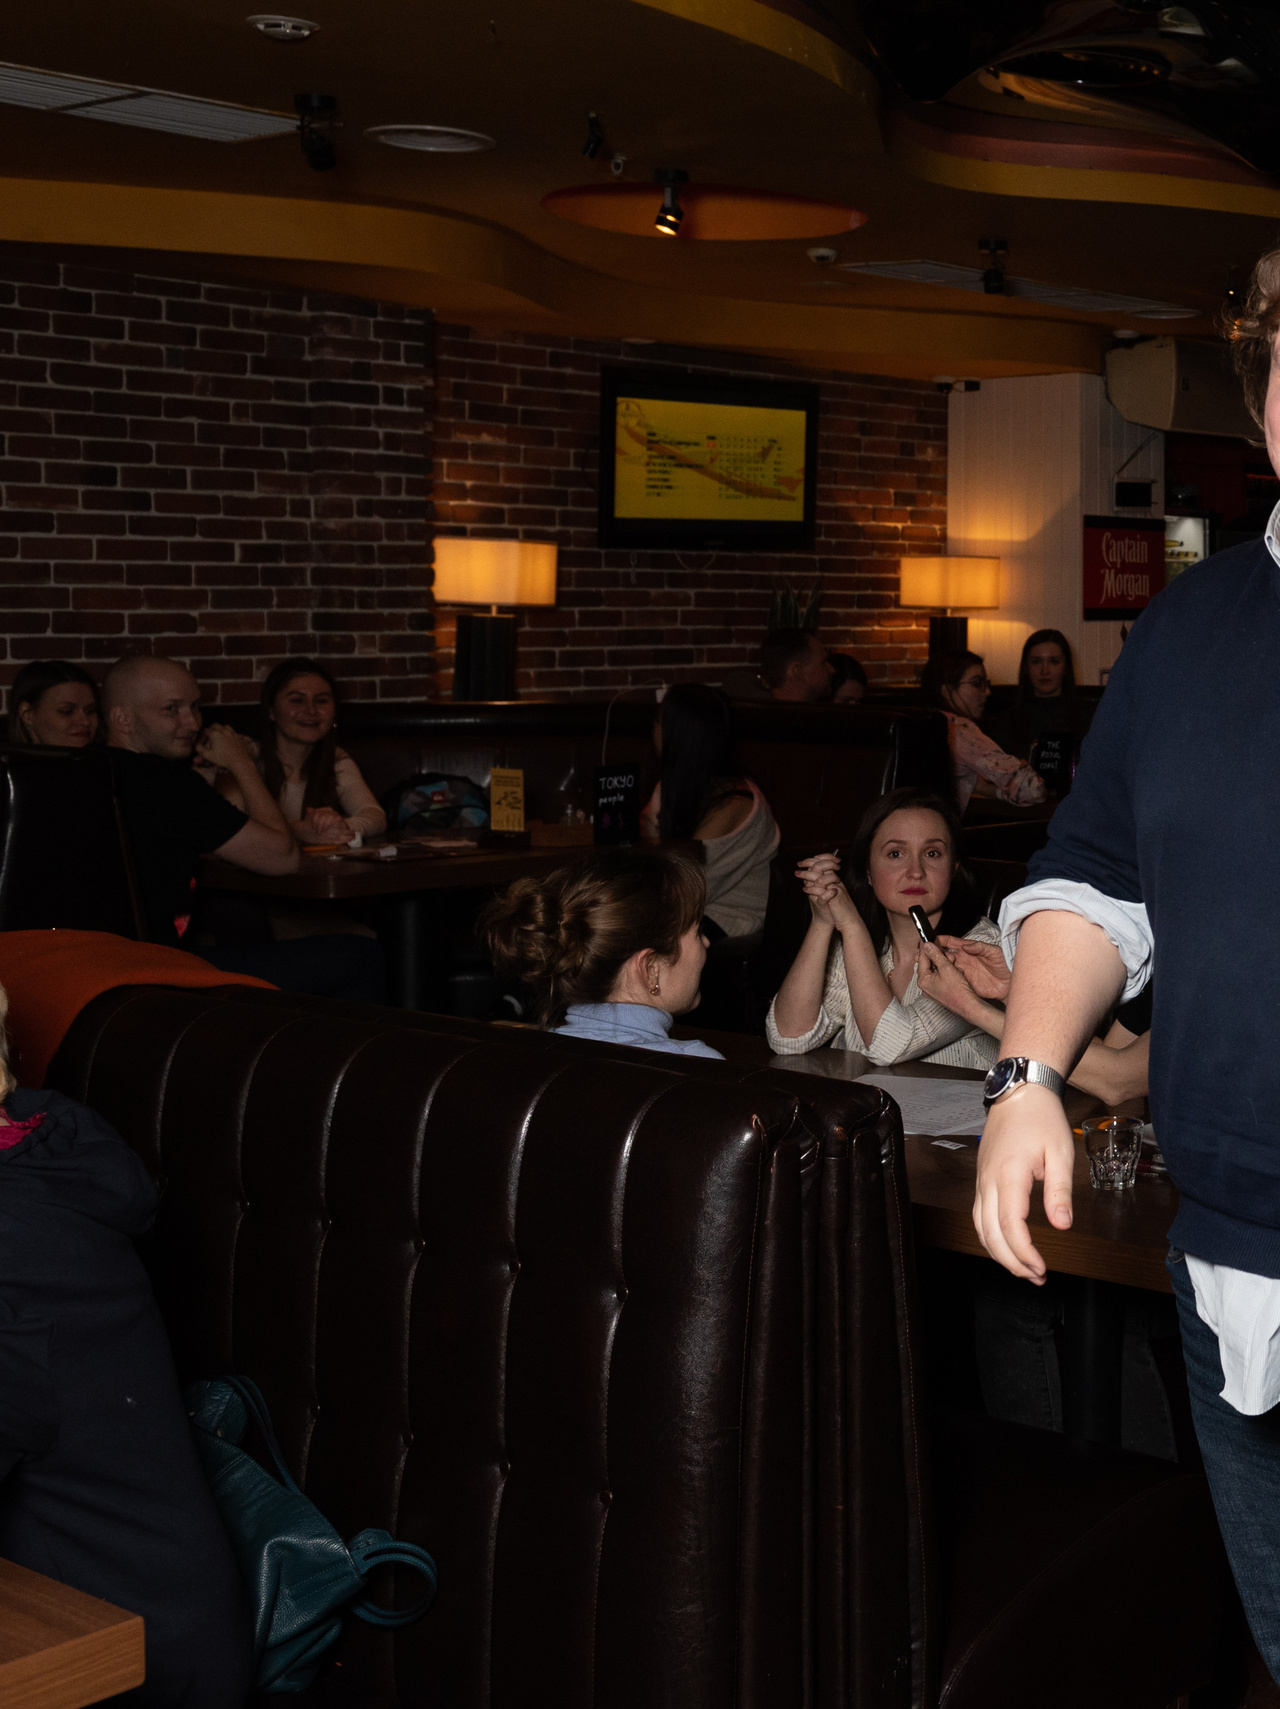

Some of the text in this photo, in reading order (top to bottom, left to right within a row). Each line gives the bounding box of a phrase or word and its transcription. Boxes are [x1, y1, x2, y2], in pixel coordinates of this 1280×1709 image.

[1102, 531, 1148, 568] Captain
[1100, 568, 1150, 605] Morgan
[599, 775, 635, 791] TOKYO
[598, 793, 625, 808] people
